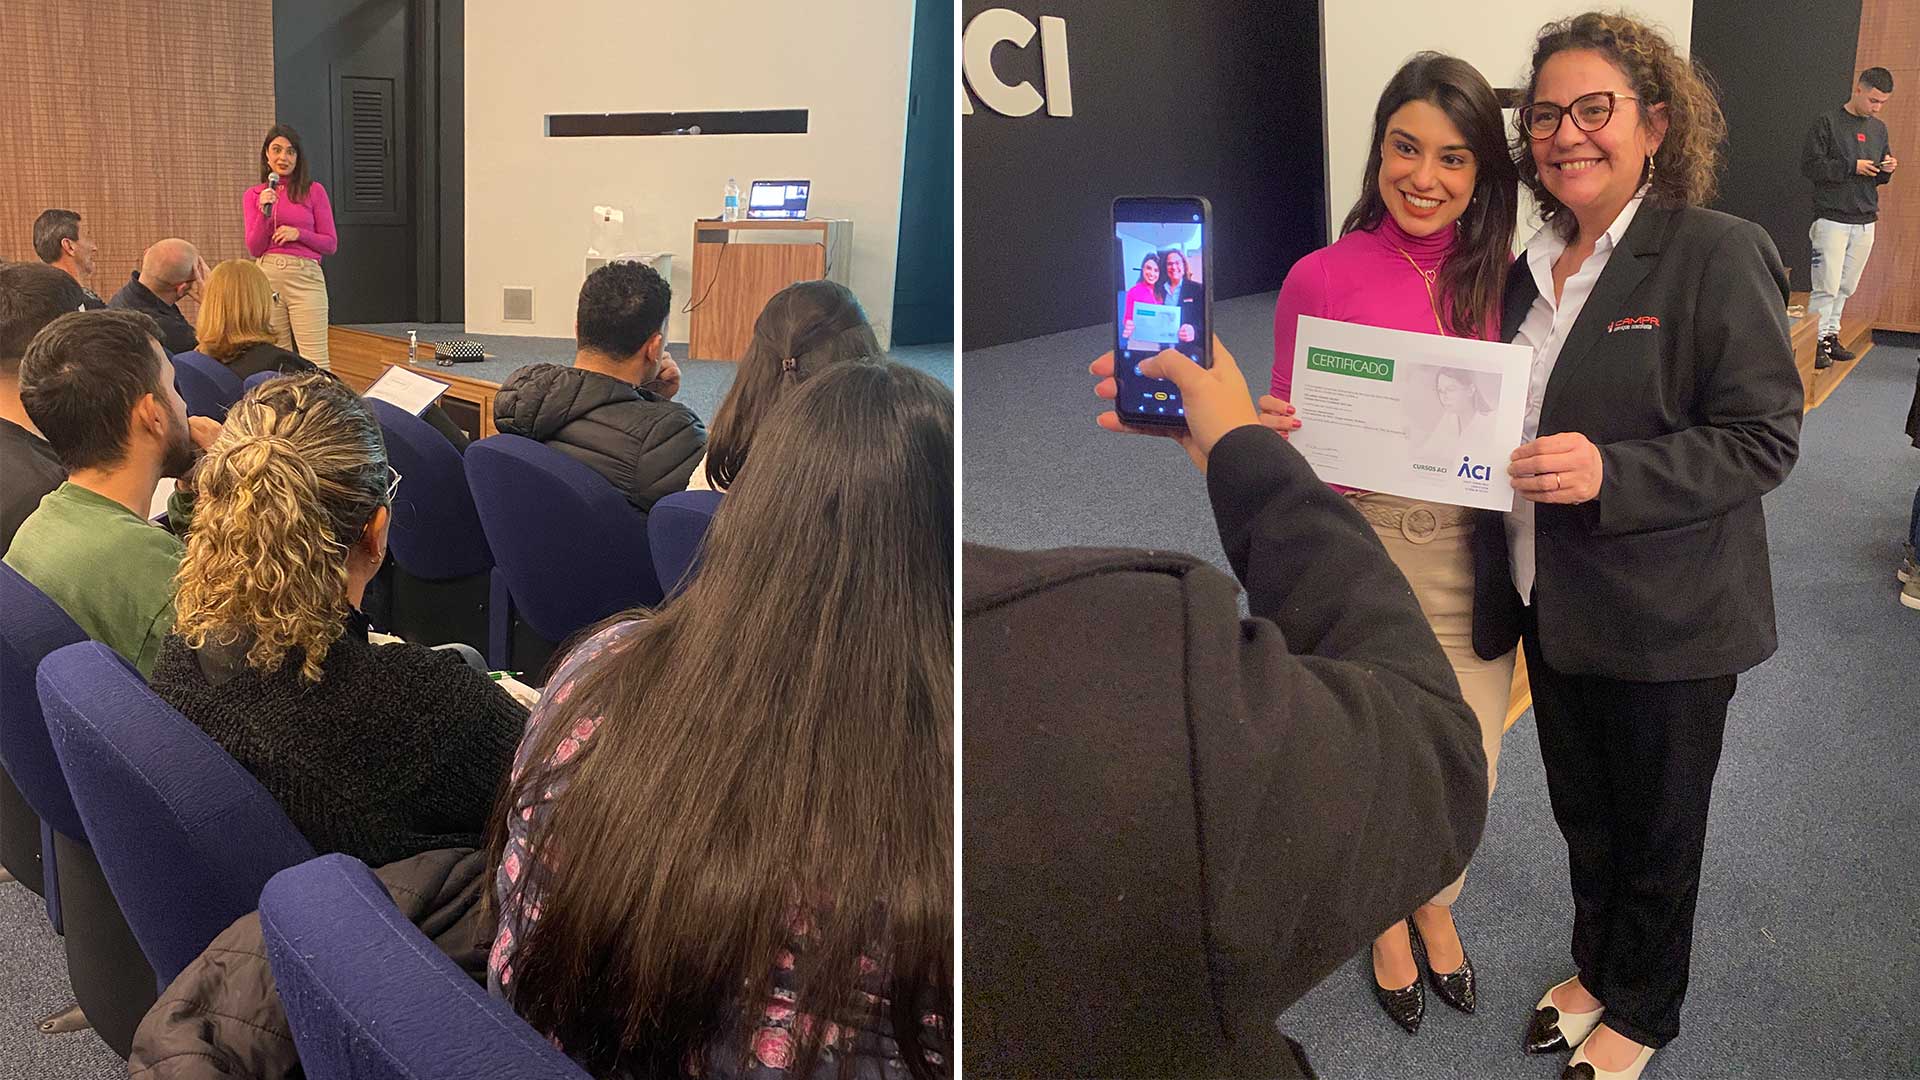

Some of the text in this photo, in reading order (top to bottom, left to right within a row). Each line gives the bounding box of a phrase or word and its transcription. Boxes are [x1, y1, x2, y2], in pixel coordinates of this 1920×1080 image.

[963, 8, 1073, 117] CI
[1312, 353, 1389, 376] CERTIFICADO
[1412, 463, 1436, 472] CURSOS
[1457, 456, 1491, 481] ACI
